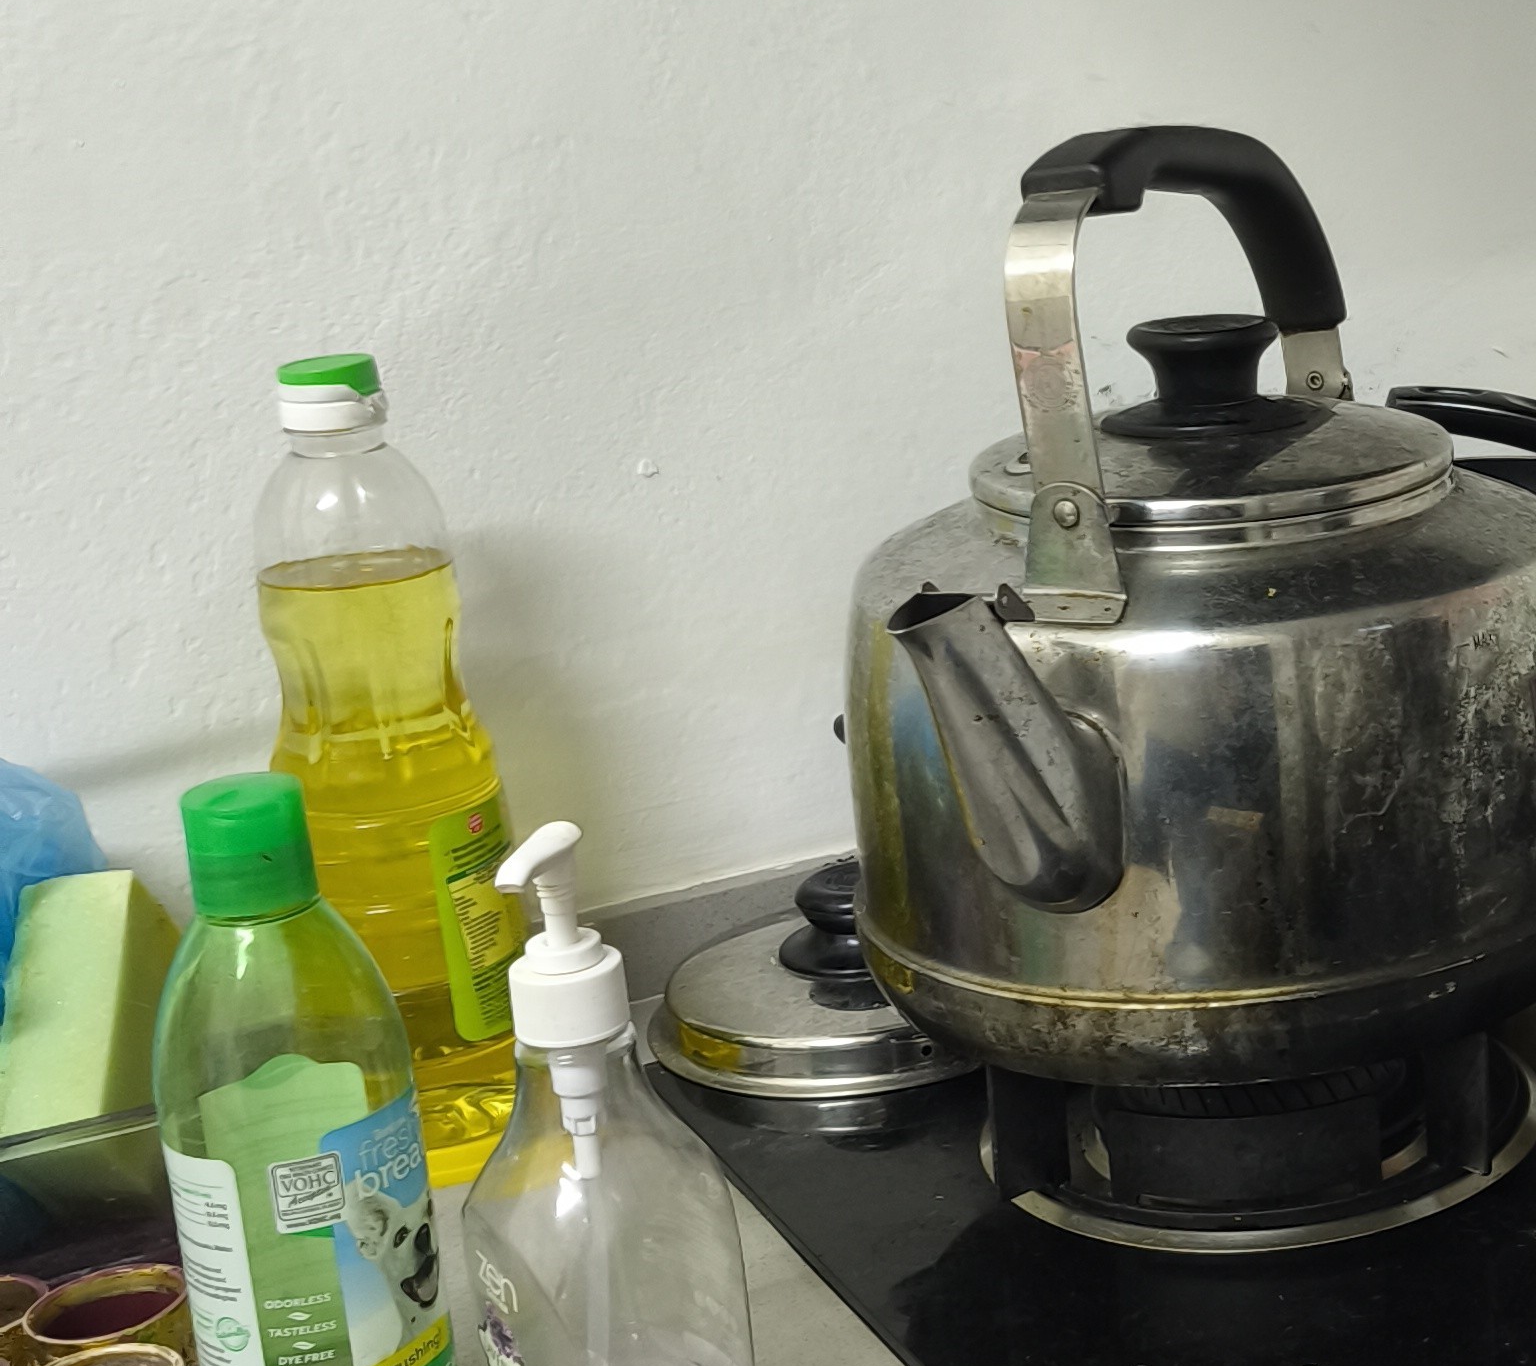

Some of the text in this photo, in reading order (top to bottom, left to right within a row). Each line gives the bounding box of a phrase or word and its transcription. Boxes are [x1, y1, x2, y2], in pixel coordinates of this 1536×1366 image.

[280, 1170, 336, 1193] VOHC
[354, 1142, 422, 1200] brea
[475, 1249, 519, 1313] zen
[263, 1292, 332, 1311] ODORLESS
[267, 1320, 337, 1338] TASTELESS
[278, 1349, 336, 1366] DYE FREE
